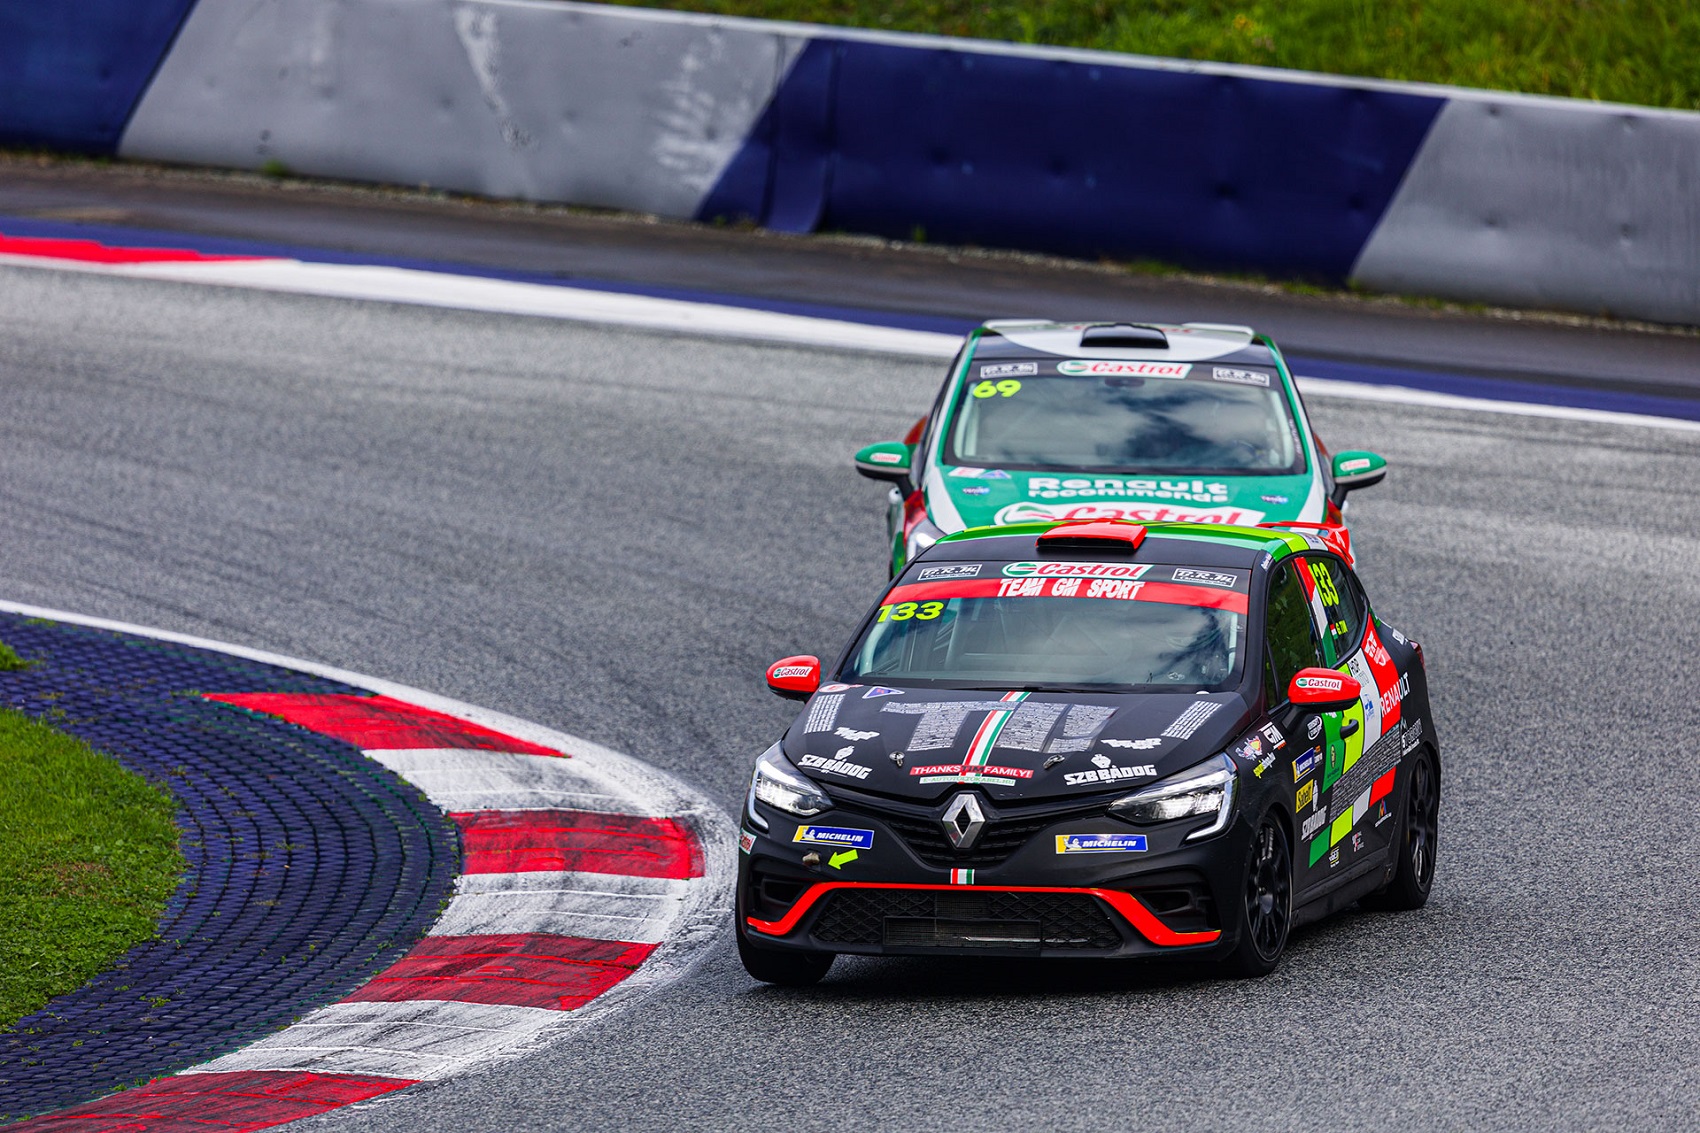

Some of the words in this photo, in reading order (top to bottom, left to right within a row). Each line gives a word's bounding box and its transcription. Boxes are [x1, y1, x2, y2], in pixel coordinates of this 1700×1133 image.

[1091, 362, 1184, 376] Castrol
[972, 379, 1021, 399] 69
[1028, 477, 1228, 495] Renault
[1028, 488, 1228, 503] recommends
[1037, 563, 1141, 577] Castrol
[997, 578, 1046, 597] TEAM
[1051, 579, 1082, 597] GM
[1086, 579, 1145, 600] SPORT
[1308, 562, 1340, 607] 133
[877, 601, 944, 623] 133
[780, 667, 811, 677] Castrol
[1308, 678, 1340, 690] Castrol
[1379, 672, 1410, 718] RENAULT
[914, 766, 960, 774] THANKS
[817, 833, 864, 842] MICHELIN
[1082, 840, 1137, 848] MICHELIN
